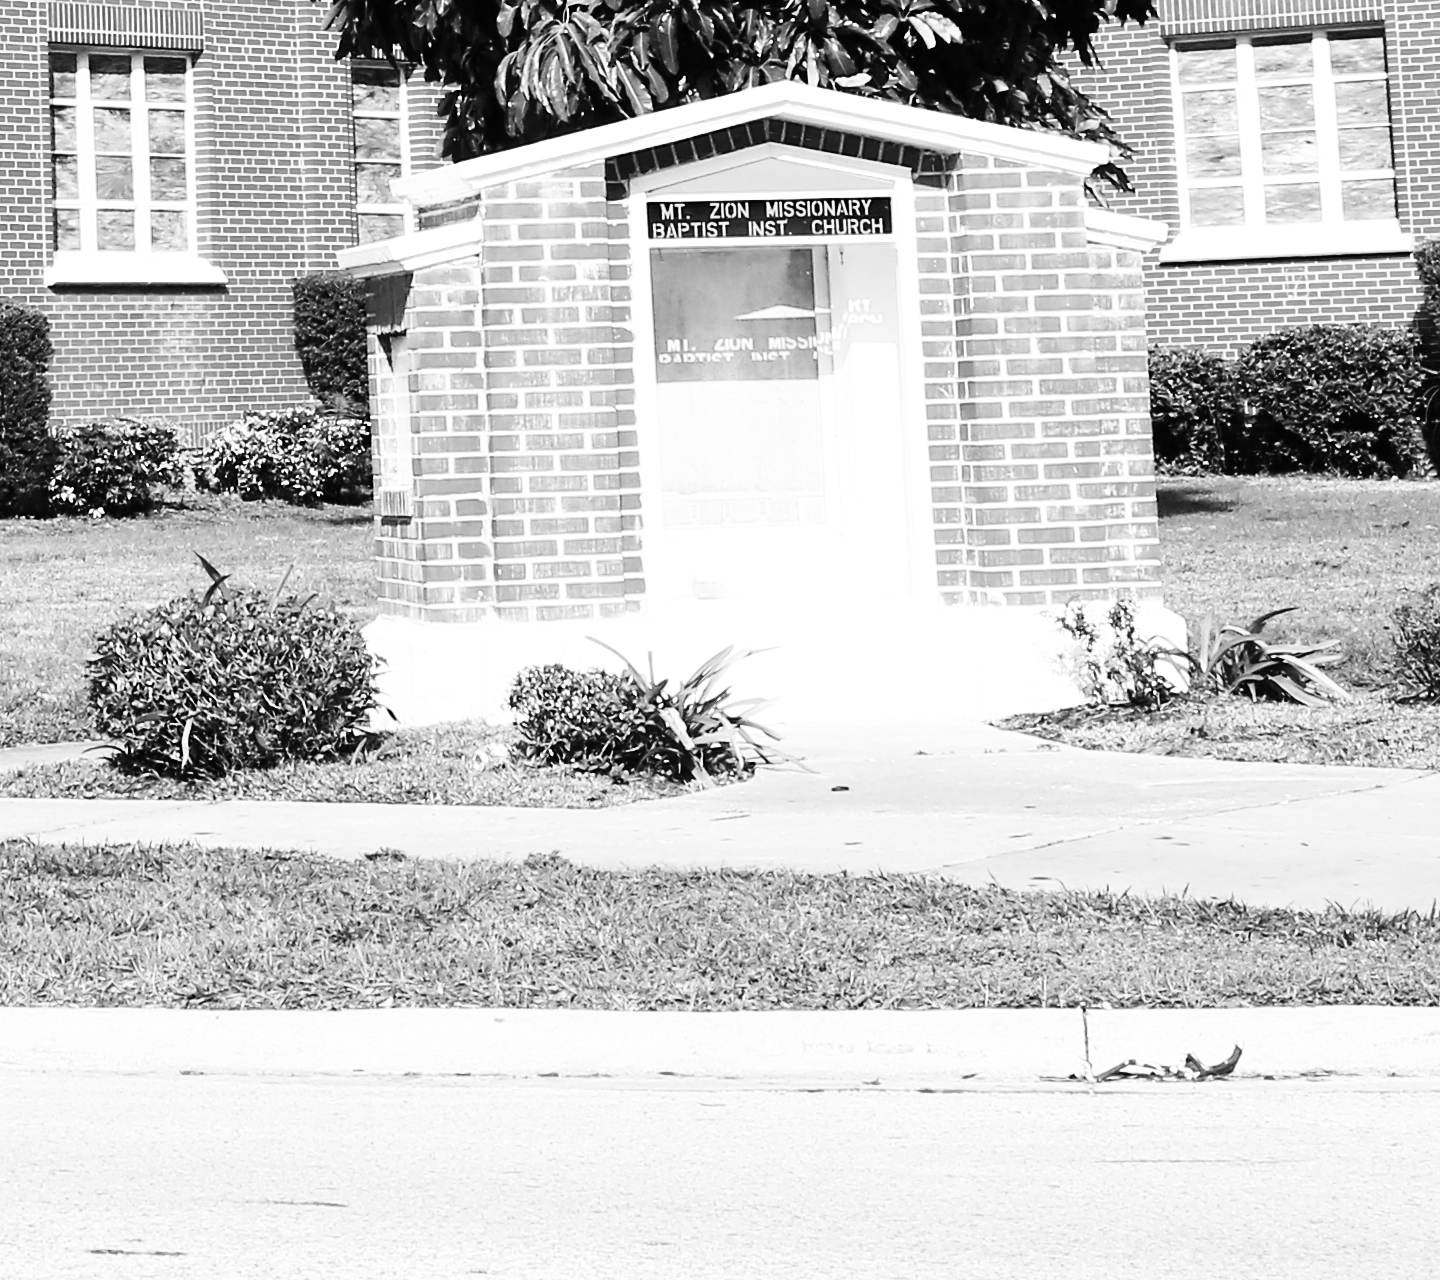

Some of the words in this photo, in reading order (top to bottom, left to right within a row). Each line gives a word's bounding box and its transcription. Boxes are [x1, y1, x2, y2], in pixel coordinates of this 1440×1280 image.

[659, 203, 691, 221] MT.
[709, 202, 750, 220] ZION
[765, 199, 872, 218] MISSIONARY
[652, 221, 730, 239] BAPTIST
[747, 219, 793, 236] INST.
[811, 218, 884, 236] CHURCH
